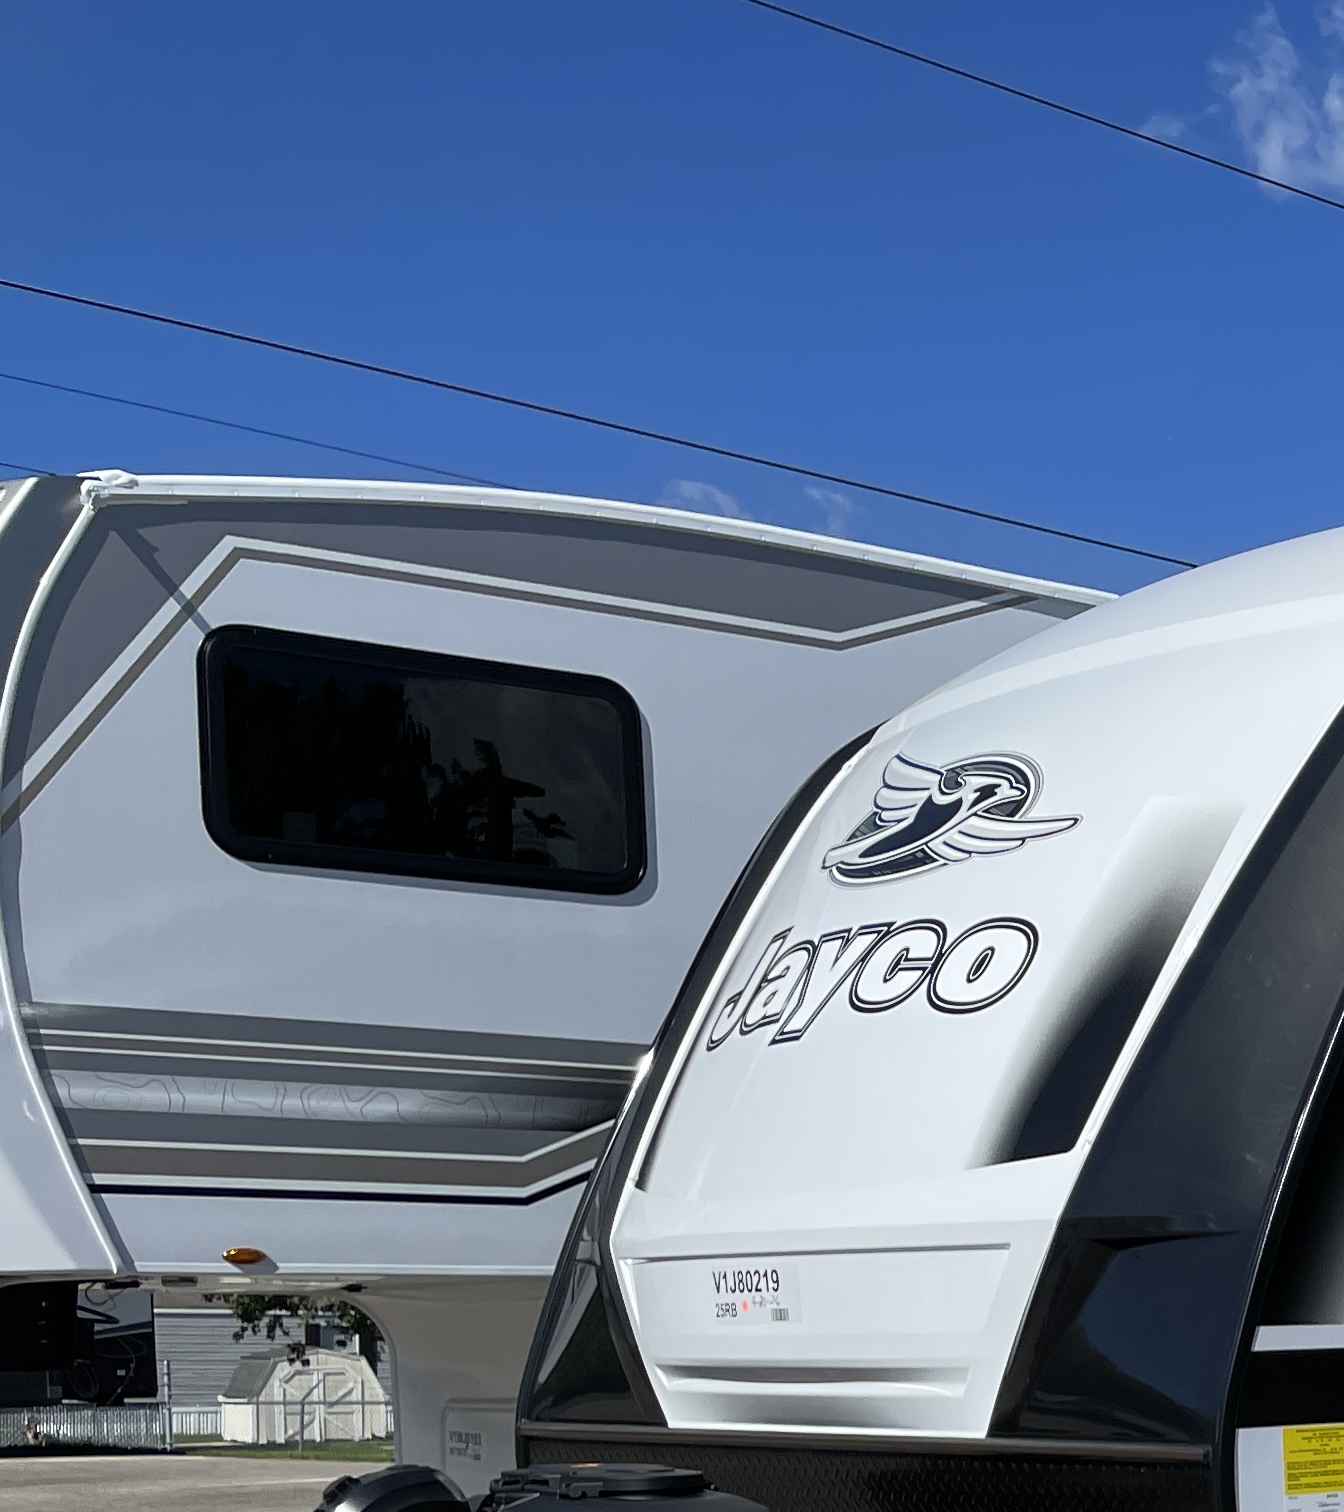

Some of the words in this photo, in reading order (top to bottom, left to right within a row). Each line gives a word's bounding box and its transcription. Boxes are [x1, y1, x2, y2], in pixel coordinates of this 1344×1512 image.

[706, 917, 1039, 1052] Jayco
[712, 1269, 780, 1294] V1J80219
[715, 1302, 738, 1318] 25RB
